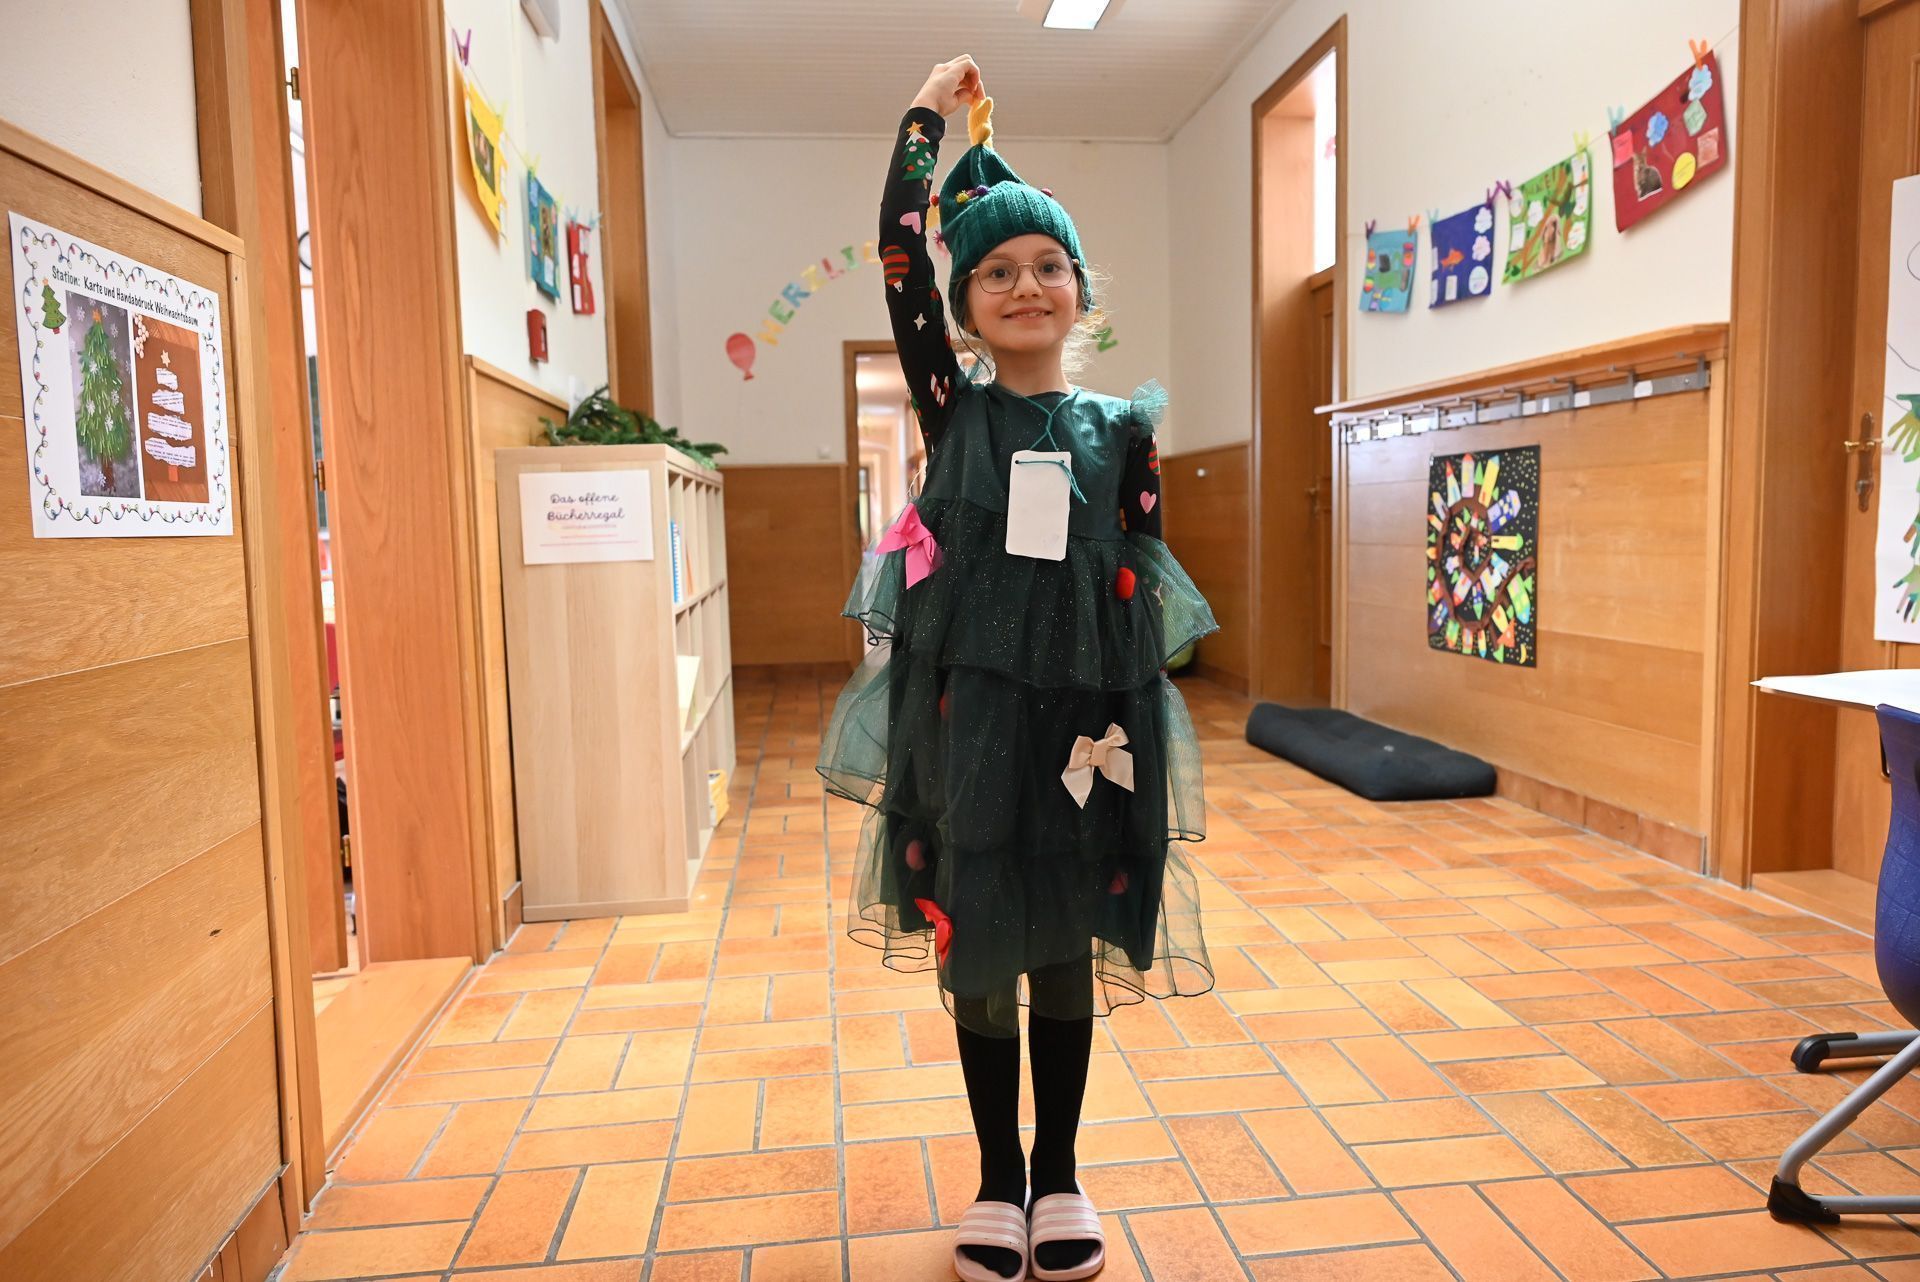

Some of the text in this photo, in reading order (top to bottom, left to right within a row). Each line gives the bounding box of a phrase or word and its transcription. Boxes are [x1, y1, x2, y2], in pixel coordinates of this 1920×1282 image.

[51, 265, 80, 287] Station:
[83, 276, 103, 295] Karte
[103, 286, 115, 299] und
[756, 240, 881, 347] HERZLIC
[550, 492, 619, 506] Das offene
[547, 508, 625, 522] Bücherregal
